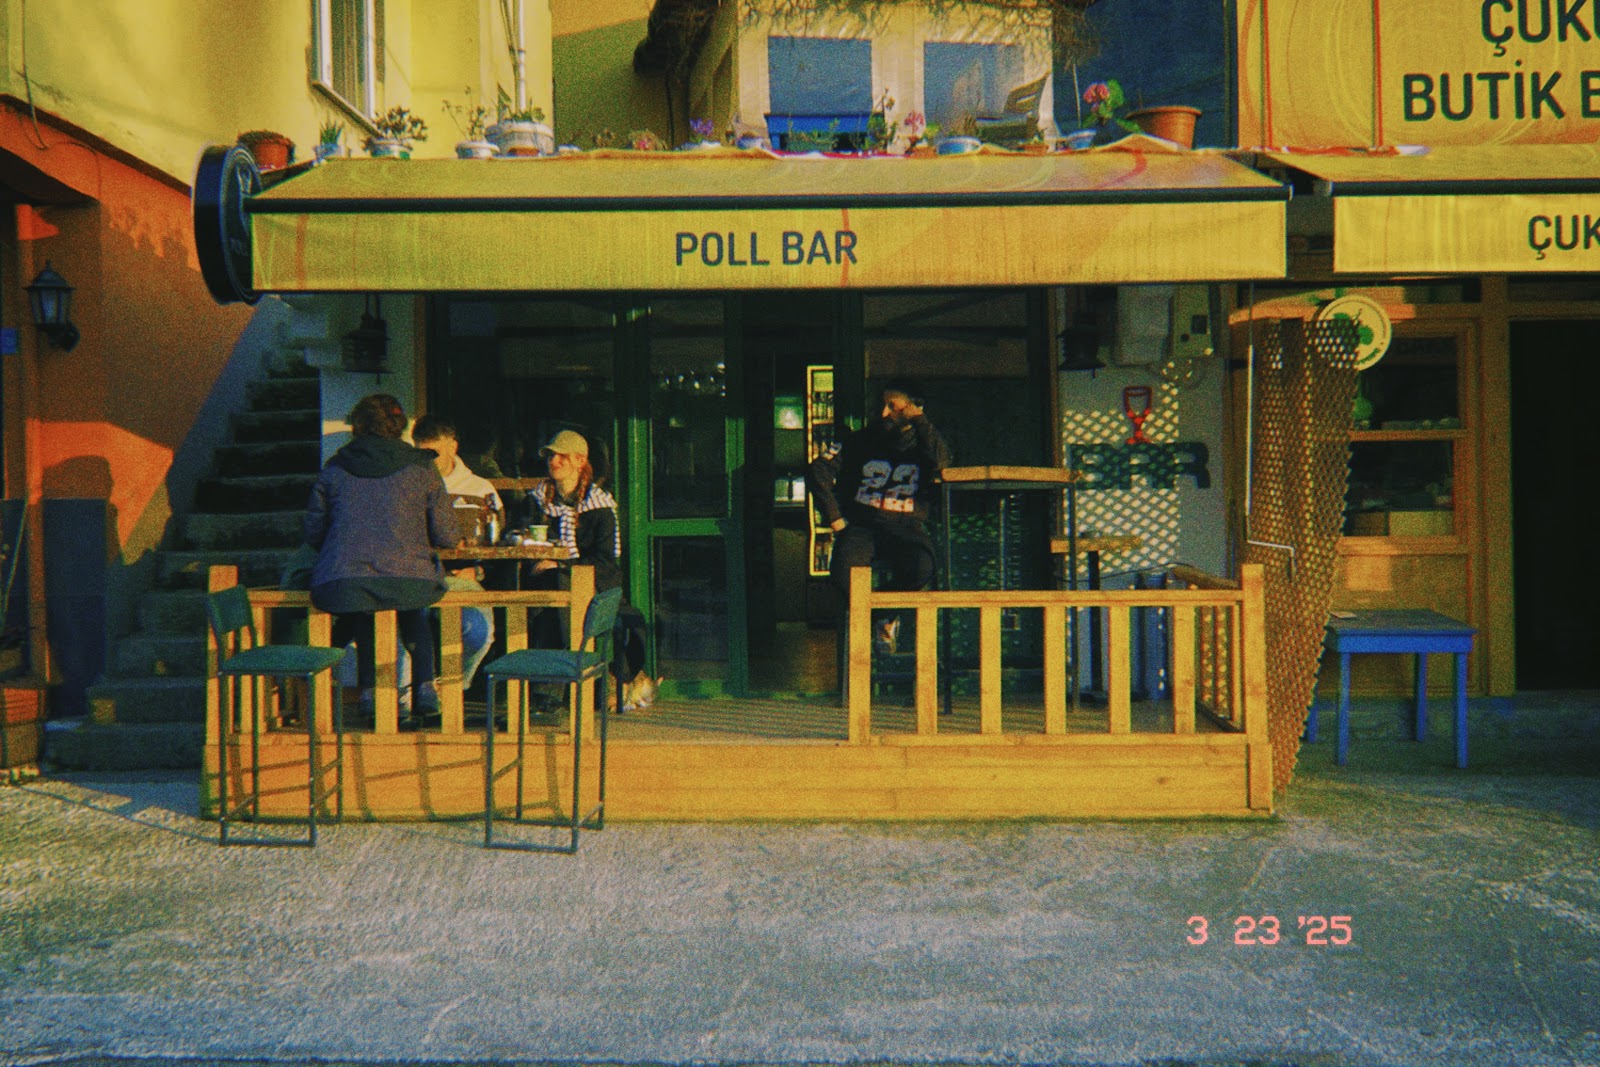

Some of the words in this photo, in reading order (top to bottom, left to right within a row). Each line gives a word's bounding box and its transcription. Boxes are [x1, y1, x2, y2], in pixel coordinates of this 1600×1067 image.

[1481, 0, 1600, 57] ÇUK
[1402, 59, 1566, 122] BUTİK
[676, 231, 770, 267] POLL
[782, 229, 858, 265] BAR
[1070, 441, 1211, 490] BAR
